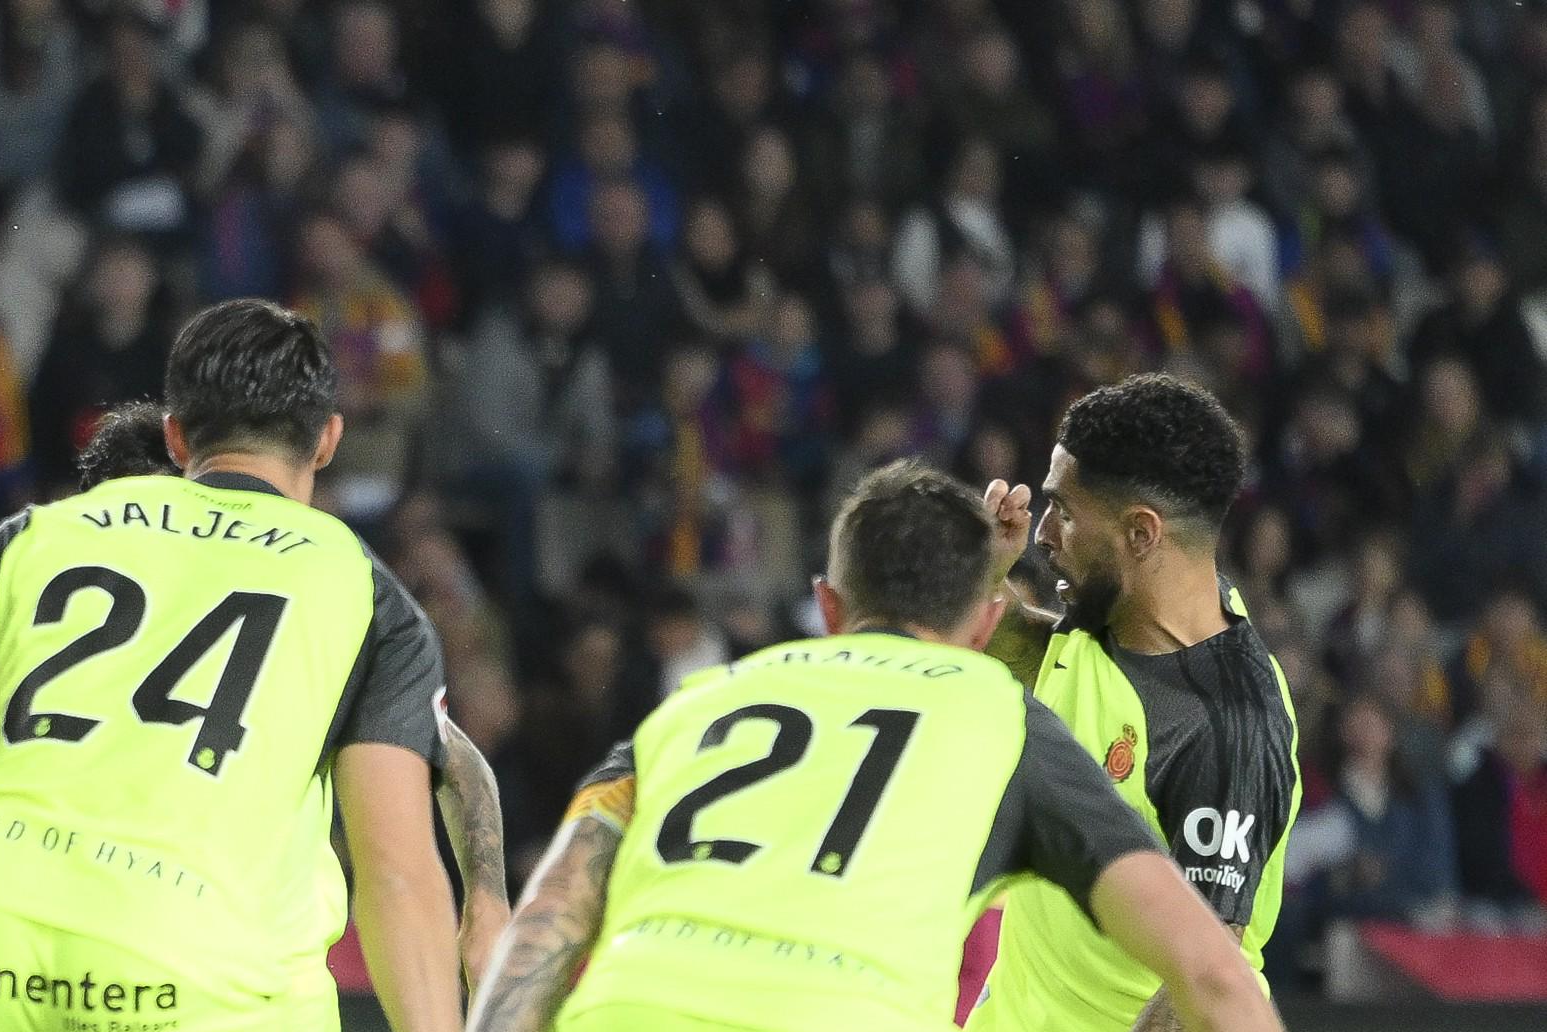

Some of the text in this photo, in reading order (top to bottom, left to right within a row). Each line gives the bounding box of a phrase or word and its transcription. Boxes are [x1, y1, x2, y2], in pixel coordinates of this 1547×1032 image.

[81, 502, 318, 554] VALJENT
[1, 564, 290, 778] 24
[655, 703, 924, 879] 21
[41, 826, 81, 855] OF
[1183, 807, 1255, 863] OK
[1185, 864, 1246, 894] moility
